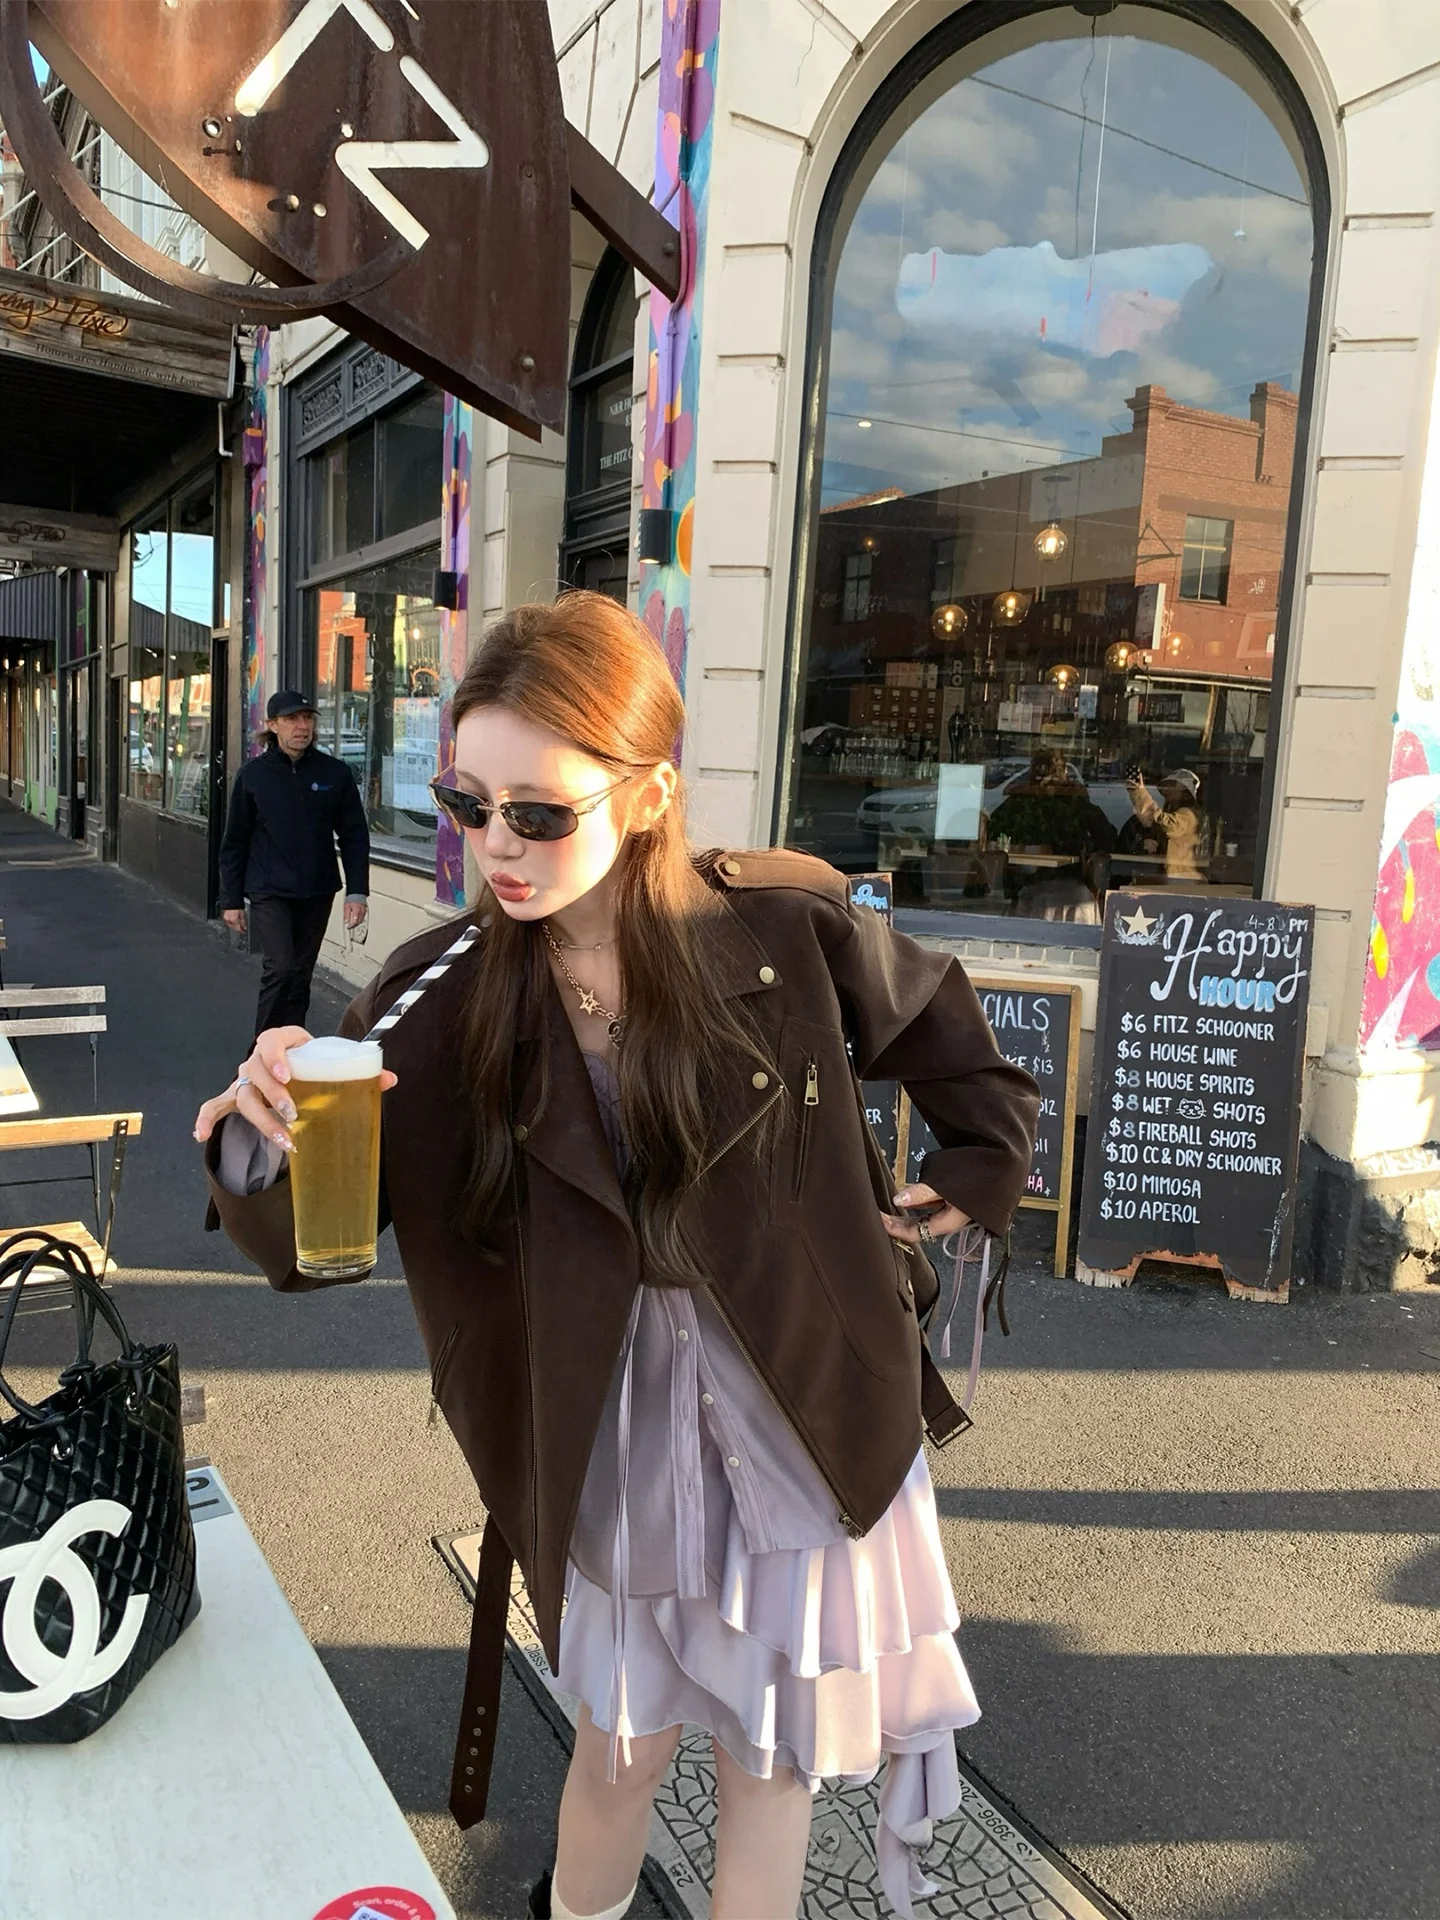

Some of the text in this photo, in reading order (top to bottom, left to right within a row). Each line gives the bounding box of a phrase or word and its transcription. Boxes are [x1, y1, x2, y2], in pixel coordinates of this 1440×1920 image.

[36, 342, 203, 388] Homewares Handmade with Love
[600, 455, 612, 470] THE
[613, 448, 628, 464] FITZ
[1150, 909, 1307, 1004] Happy
[1199, 975, 1276, 1013] HOUR
[977, 993, 1050, 1031] CIALS
[1121, 1012, 1275, 1042] $6 FITZ SCHOONER
[1032, 1055, 1054, 1076] $13
[1117, 1039, 1239, 1068] $6 HOUSE WINE
[1114, 1066, 1256, 1096] $8 HOUSE SPIRITS
[865, 1108, 883, 1125] ER
[1111, 1091, 1139, 1112] $8
[1213, 1101, 1266, 1125] SHOTS
[1108, 1117, 1257, 1150] $8 FIREBALL SHOTS
[1105, 1141, 1139, 1163] $10
[1175, 1148, 1203, 1168] DRY
[1206, 1152, 1282, 1175] SCHOONER
[1025, 1175, 1043, 1193] HA
[1103, 1170, 1201, 1199] $10 MIMOSA
[1100, 1197, 1201, 1224] $10 APEROL
[508, 1618, 532, 1641] 2006
[524, 1642, 547, 1667] Class
[384, 1898, 411, 1910] order
